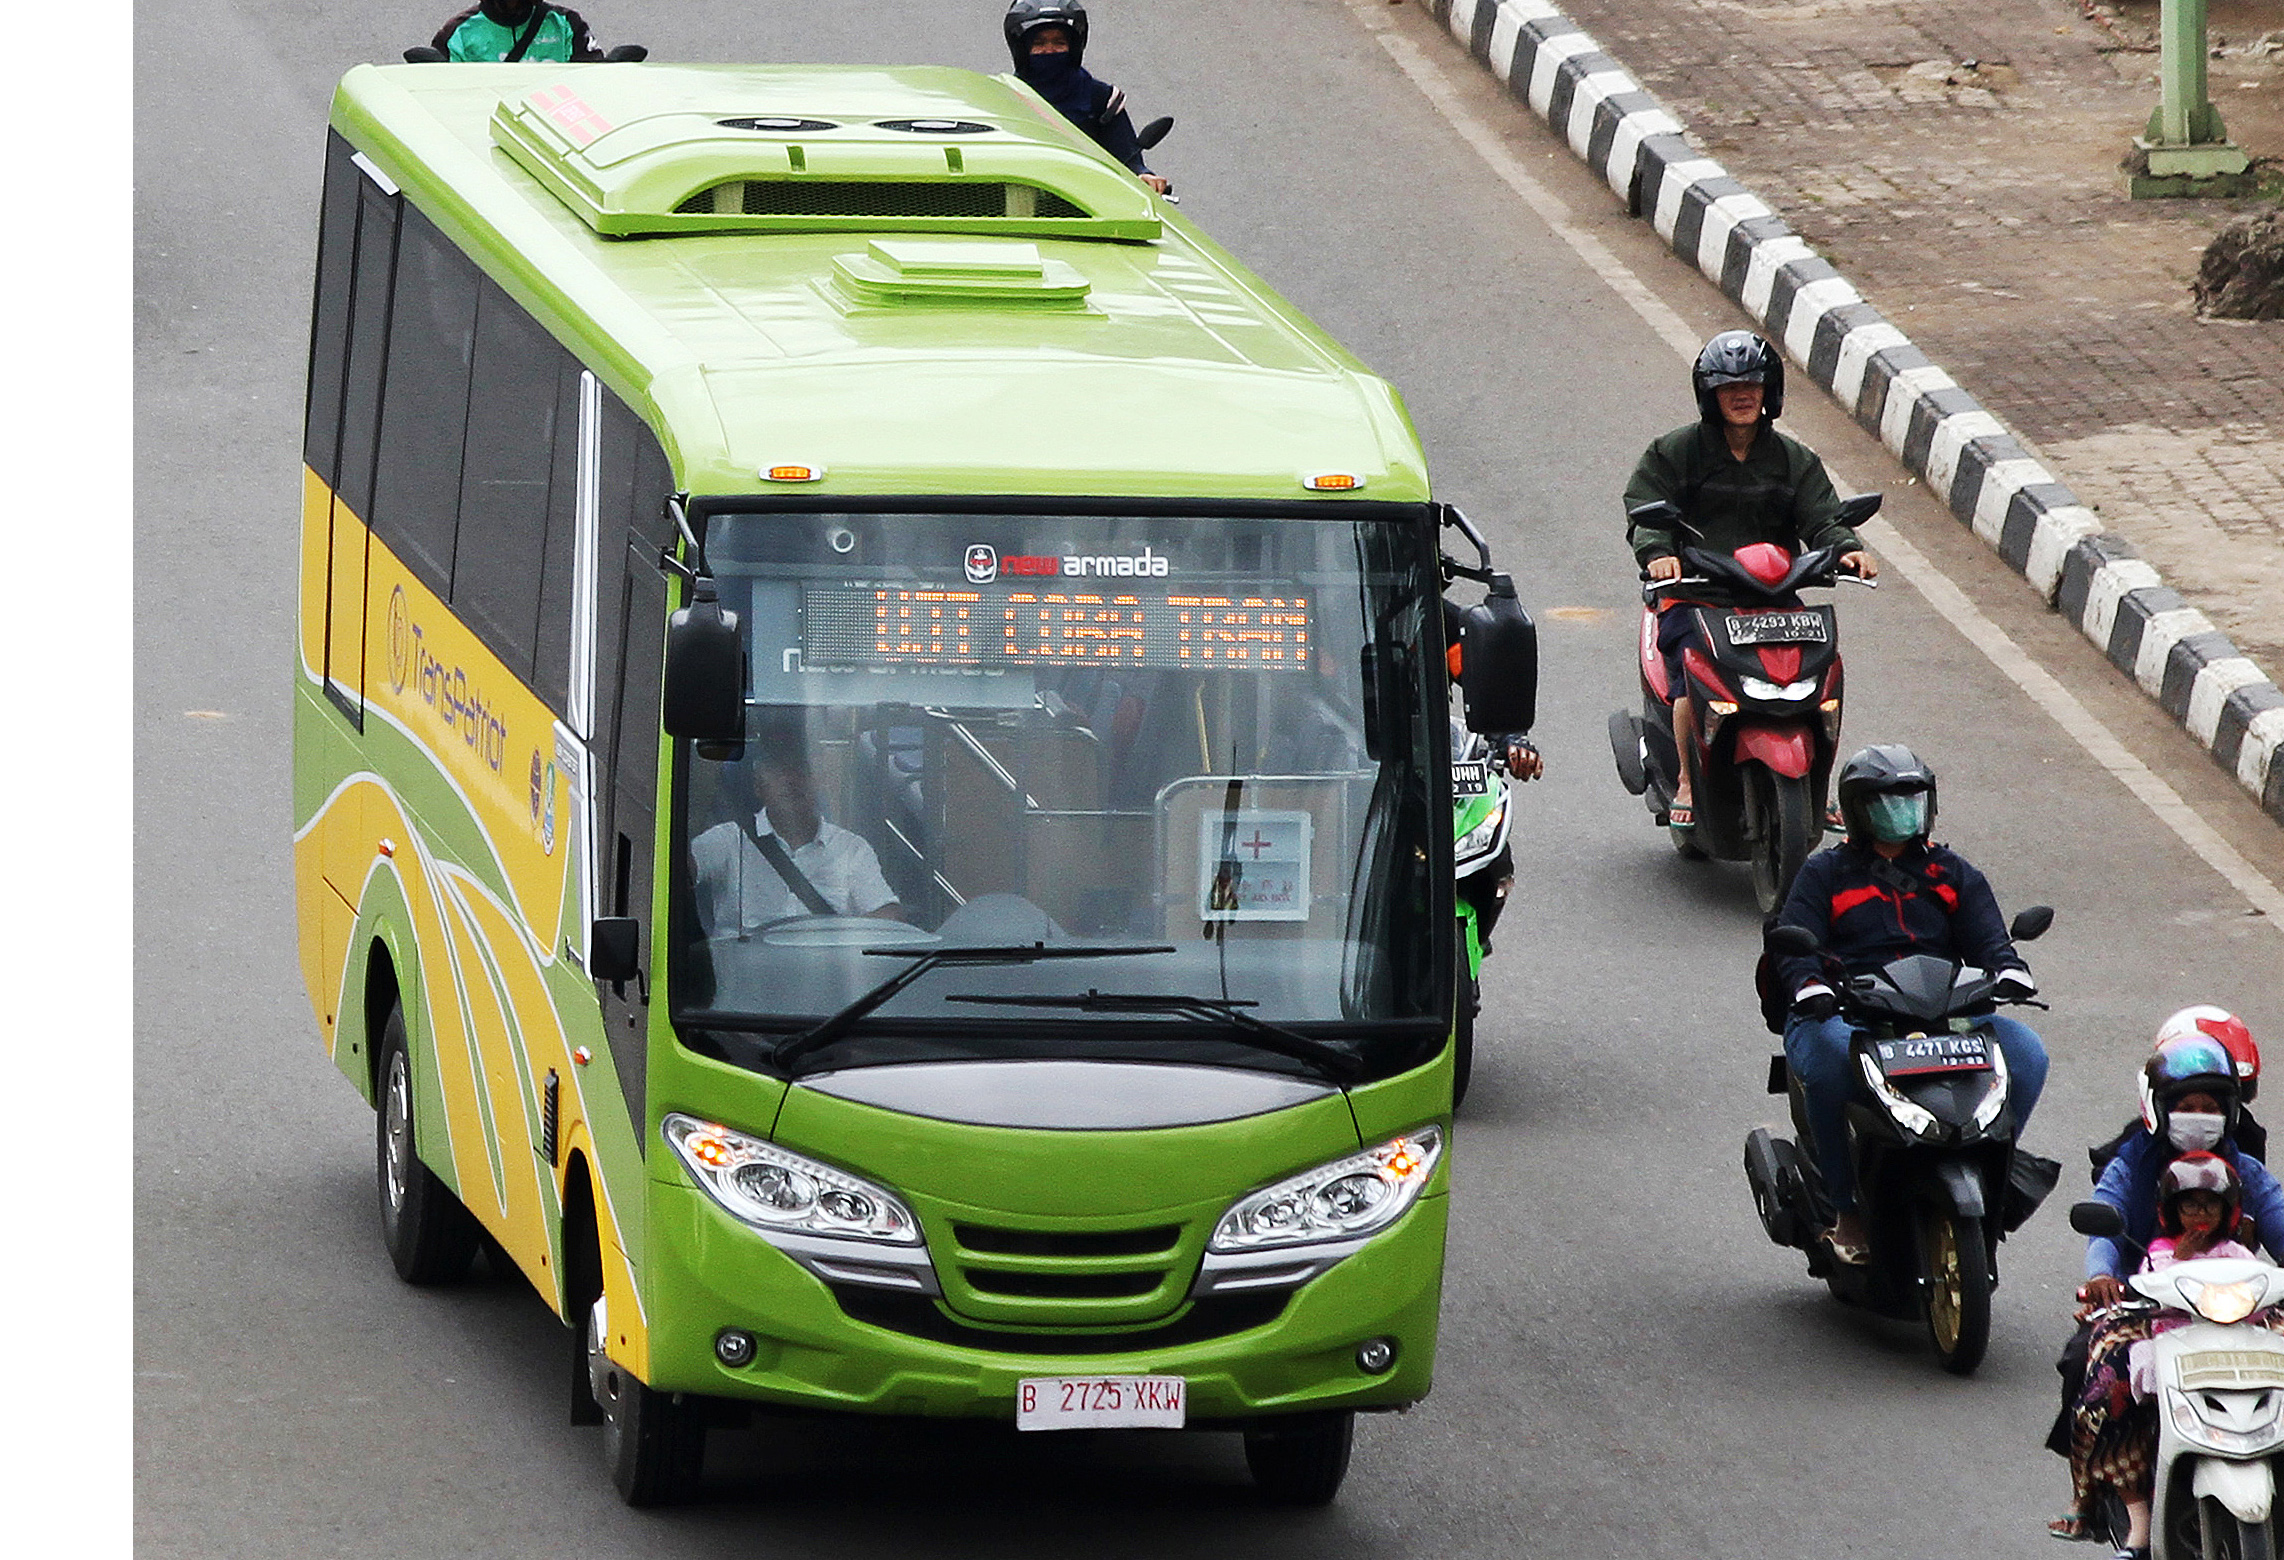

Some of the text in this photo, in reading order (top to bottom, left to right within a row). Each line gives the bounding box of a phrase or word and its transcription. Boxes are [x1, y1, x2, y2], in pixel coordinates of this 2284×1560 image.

[1001, 547, 1169, 577] new armada
[1730, 619, 1741, 631] B
[1751, 616, 1786, 629] 4293
[411, 622, 506, 778] TransPatriot
[1452, 765, 1480, 781] UHH
[1022, 1381, 1181, 1413] B 2725 XKW
